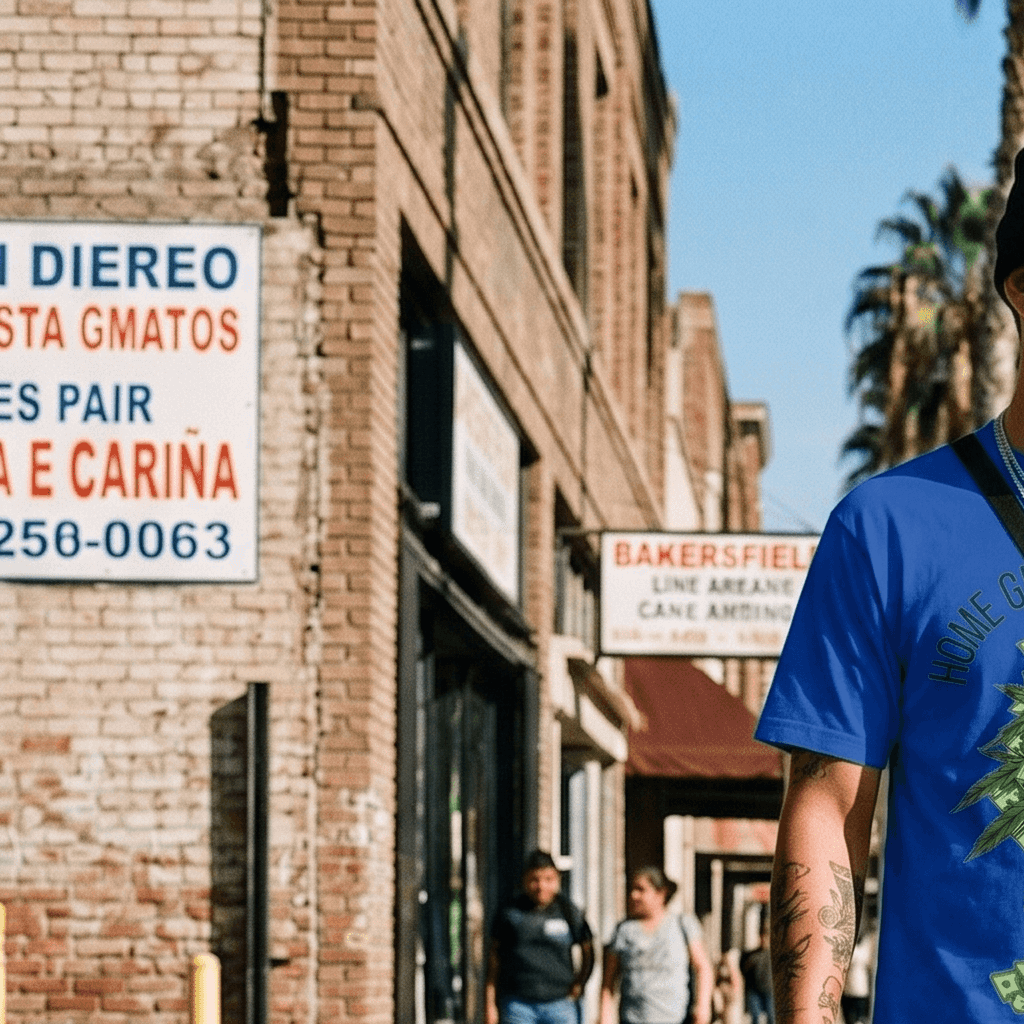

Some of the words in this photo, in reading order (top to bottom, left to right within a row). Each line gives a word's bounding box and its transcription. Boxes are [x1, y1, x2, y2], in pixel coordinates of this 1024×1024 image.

[32, 245, 239, 290] DIEREO
[81, 305, 239, 353] GMATOS
[58, 383, 153, 423] PAIR
[31, 440, 52, 498] E
[71, 427, 240, 500] CARIÑA
[614, 541, 816, 571] BAKERSFIEL
[928, 590, 1005, 686] HOME
